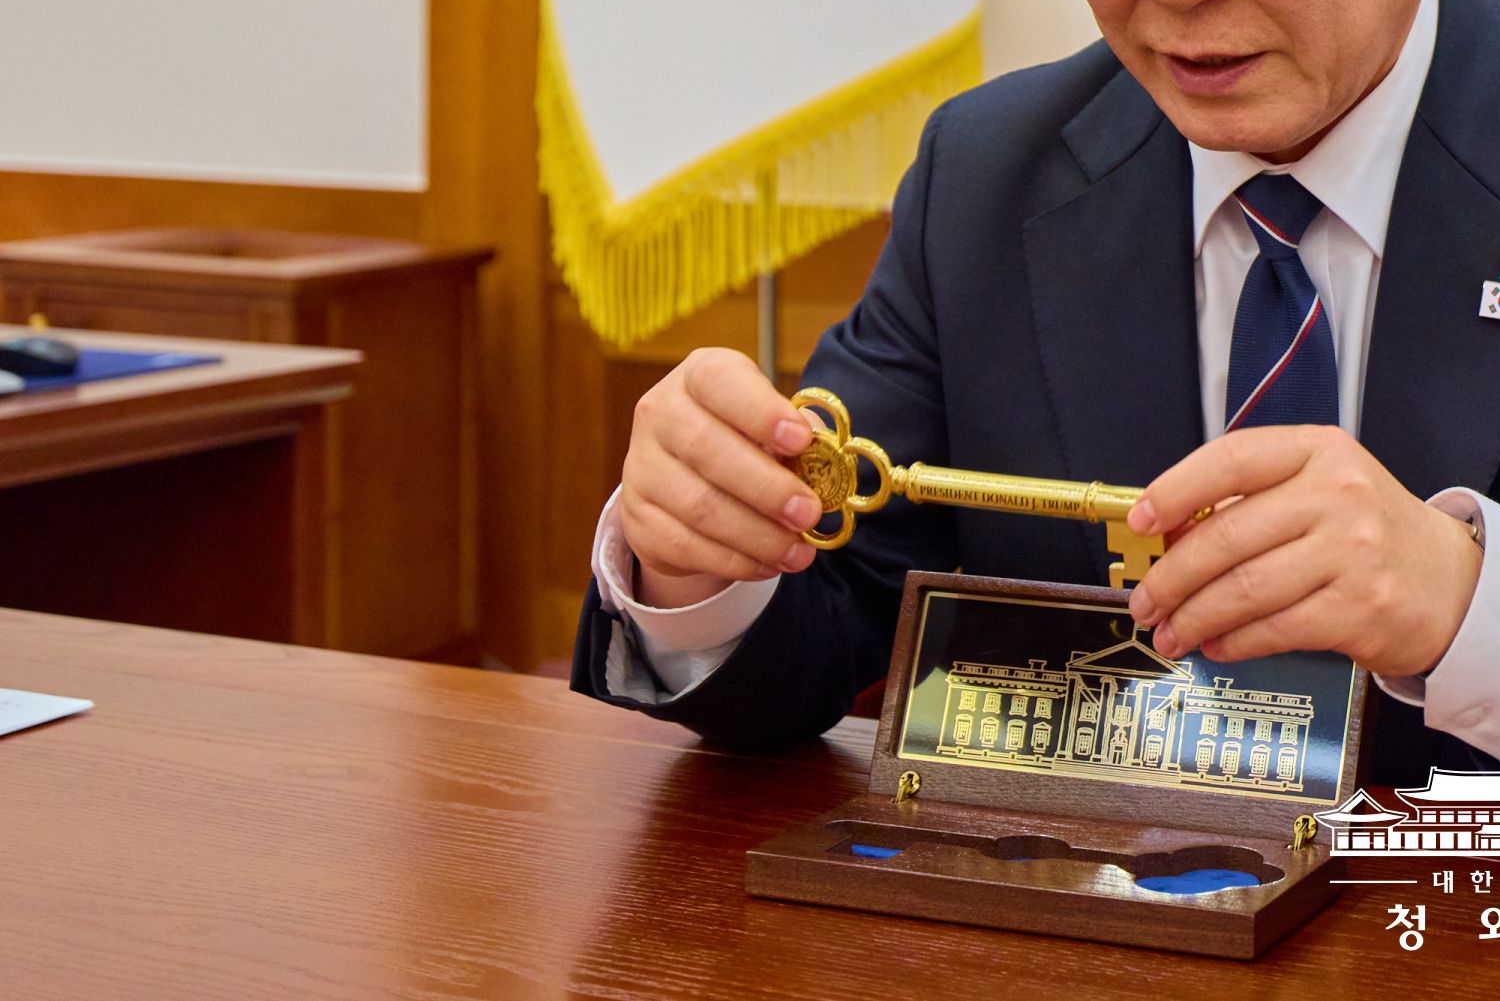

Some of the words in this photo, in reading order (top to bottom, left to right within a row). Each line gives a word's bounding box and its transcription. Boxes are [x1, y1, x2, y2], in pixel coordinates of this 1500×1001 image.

[920, 485, 978, 502] PRESIDENT
[982, 492, 1029, 507] DONALD
[1041, 498, 1081, 512] TRUMP
